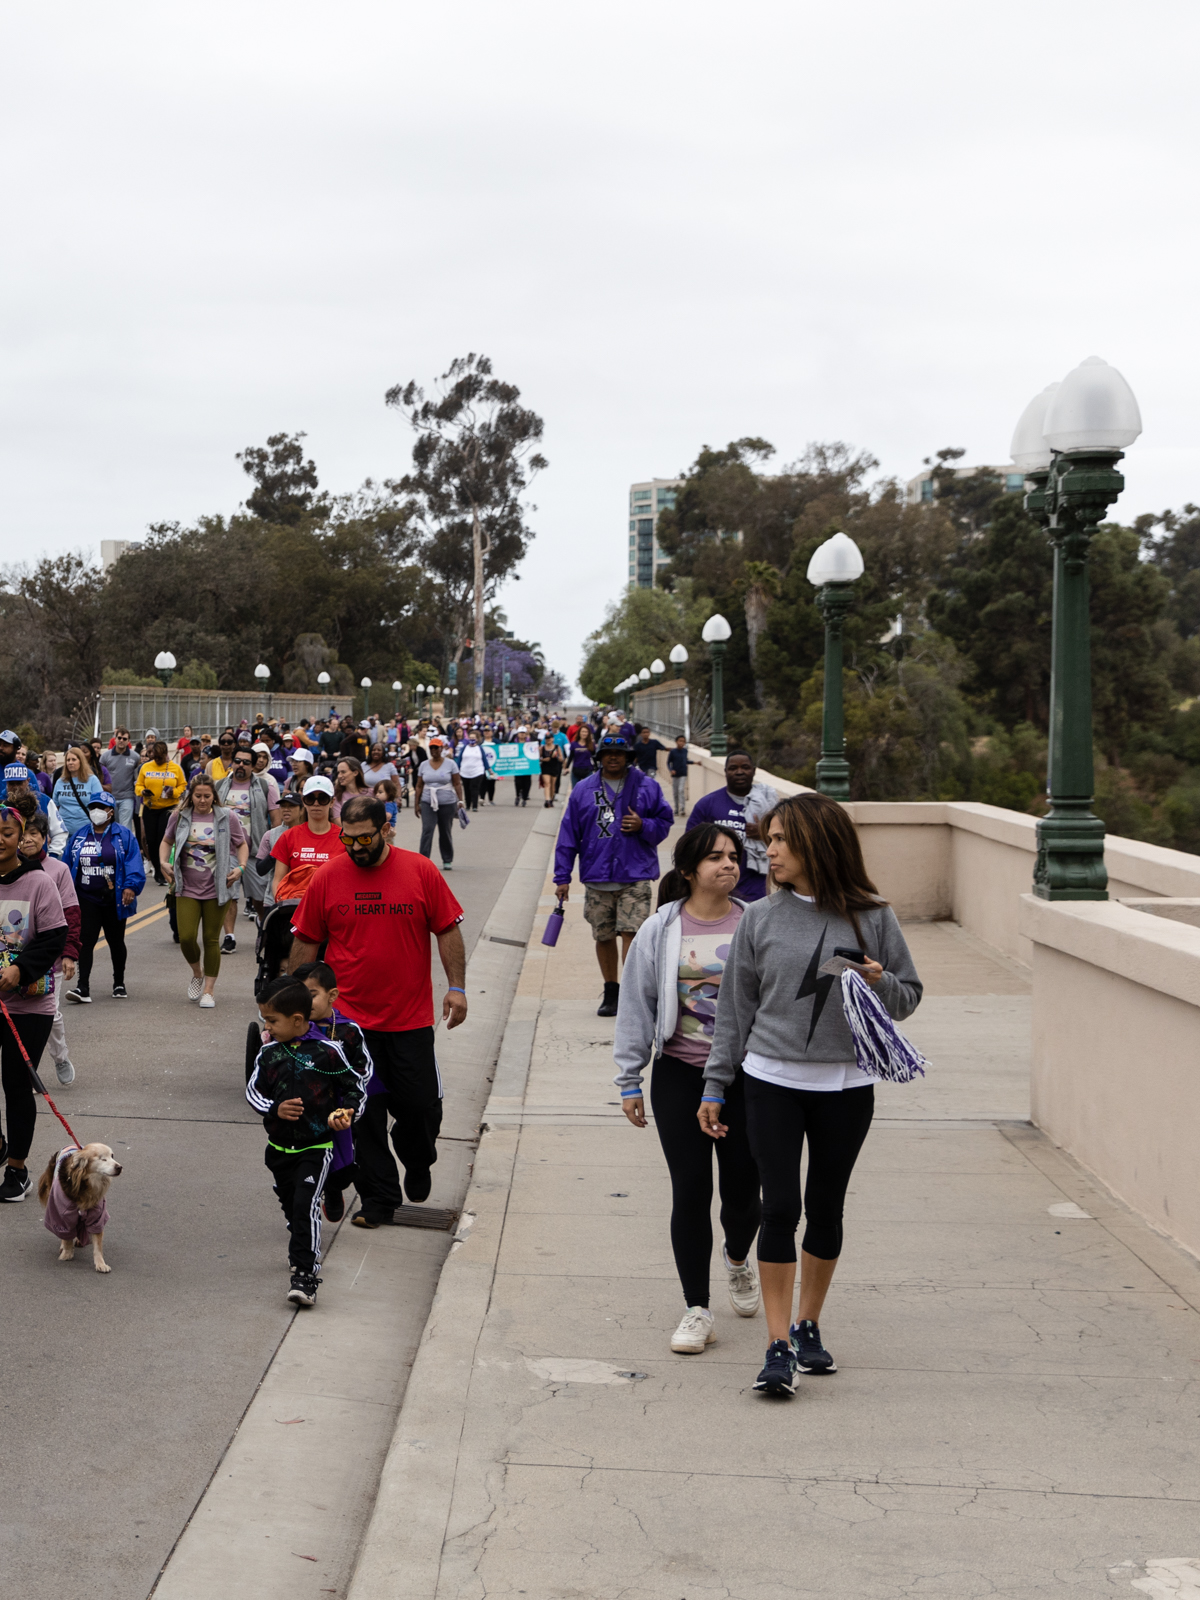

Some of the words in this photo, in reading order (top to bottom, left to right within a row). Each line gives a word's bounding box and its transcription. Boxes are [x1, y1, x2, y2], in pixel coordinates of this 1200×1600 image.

[4, 767, 28, 778] GOMAB
[80, 846, 102, 854] MARC
[80, 856, 91, 867] FOR
[355, 904, 386, 915] HEART
[390, 904, 414, 915] HATS
